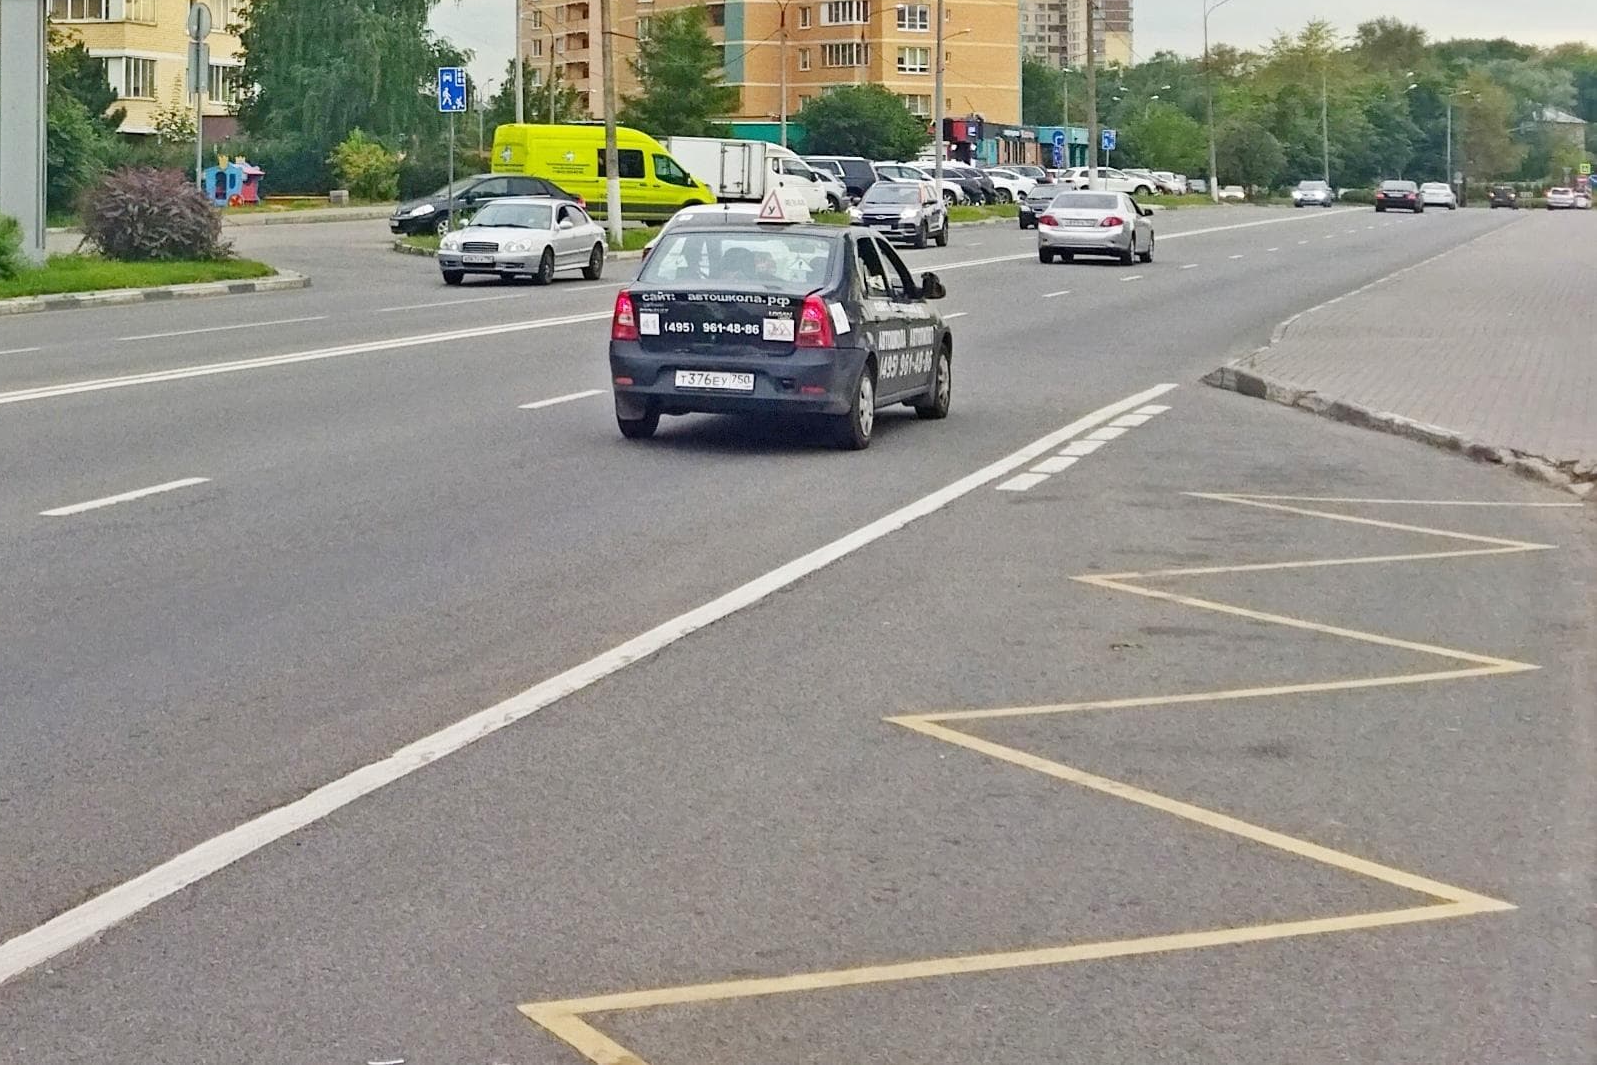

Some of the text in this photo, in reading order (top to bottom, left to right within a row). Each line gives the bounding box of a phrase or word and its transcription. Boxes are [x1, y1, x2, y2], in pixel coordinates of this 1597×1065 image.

[642, 291, 791, 308] сайт: автошкола.рф
[664, 322, 695, 334] (495)
[703, 322, 760, 335] 961-48-86
